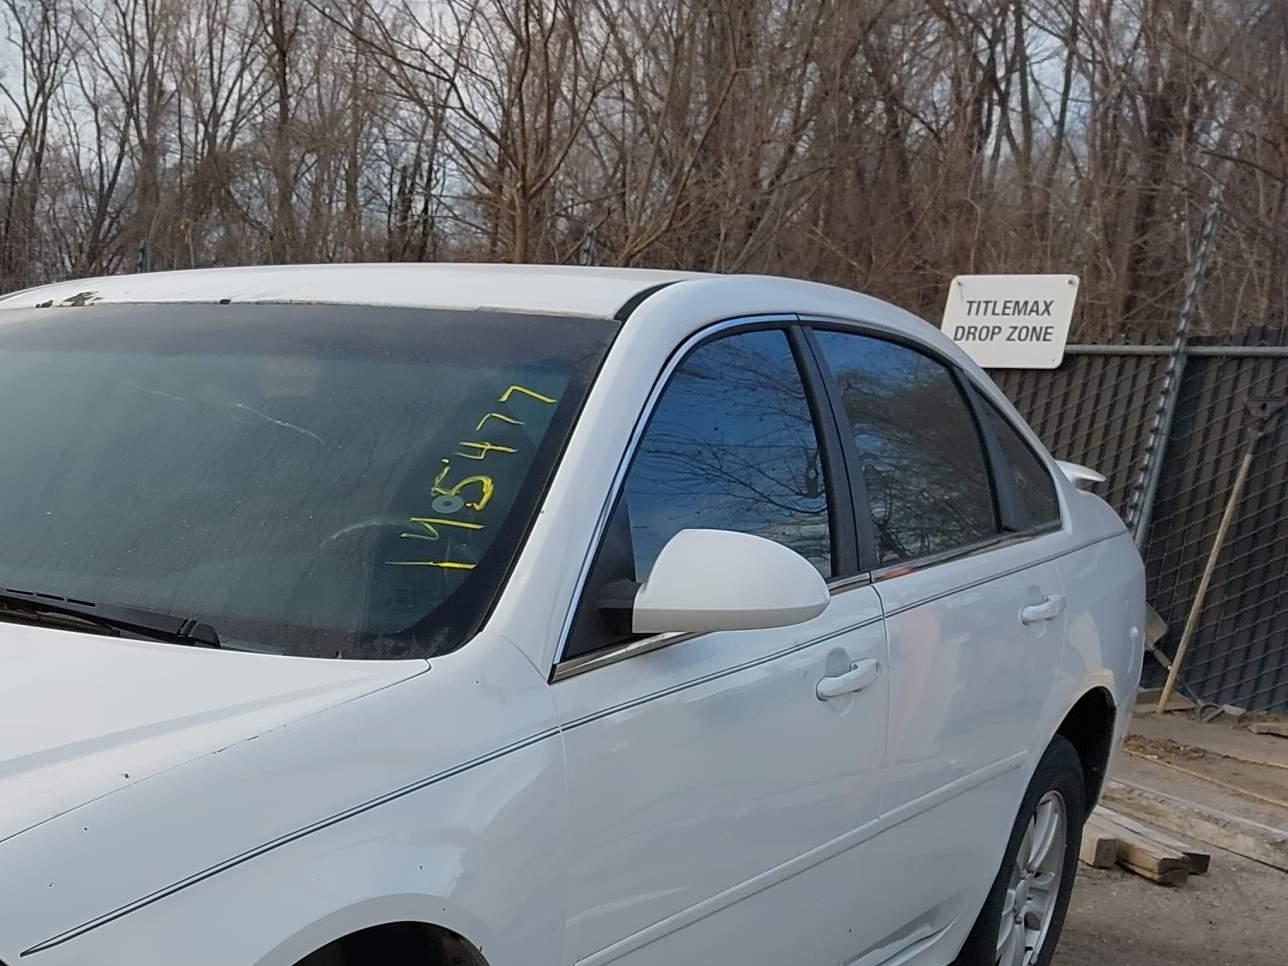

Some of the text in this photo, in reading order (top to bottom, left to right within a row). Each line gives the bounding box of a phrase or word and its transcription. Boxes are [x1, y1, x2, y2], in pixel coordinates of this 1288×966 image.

[966, 300, 1054, 317] TITLEMAX
[953, 325, 1054, 342] DROP ZONE
